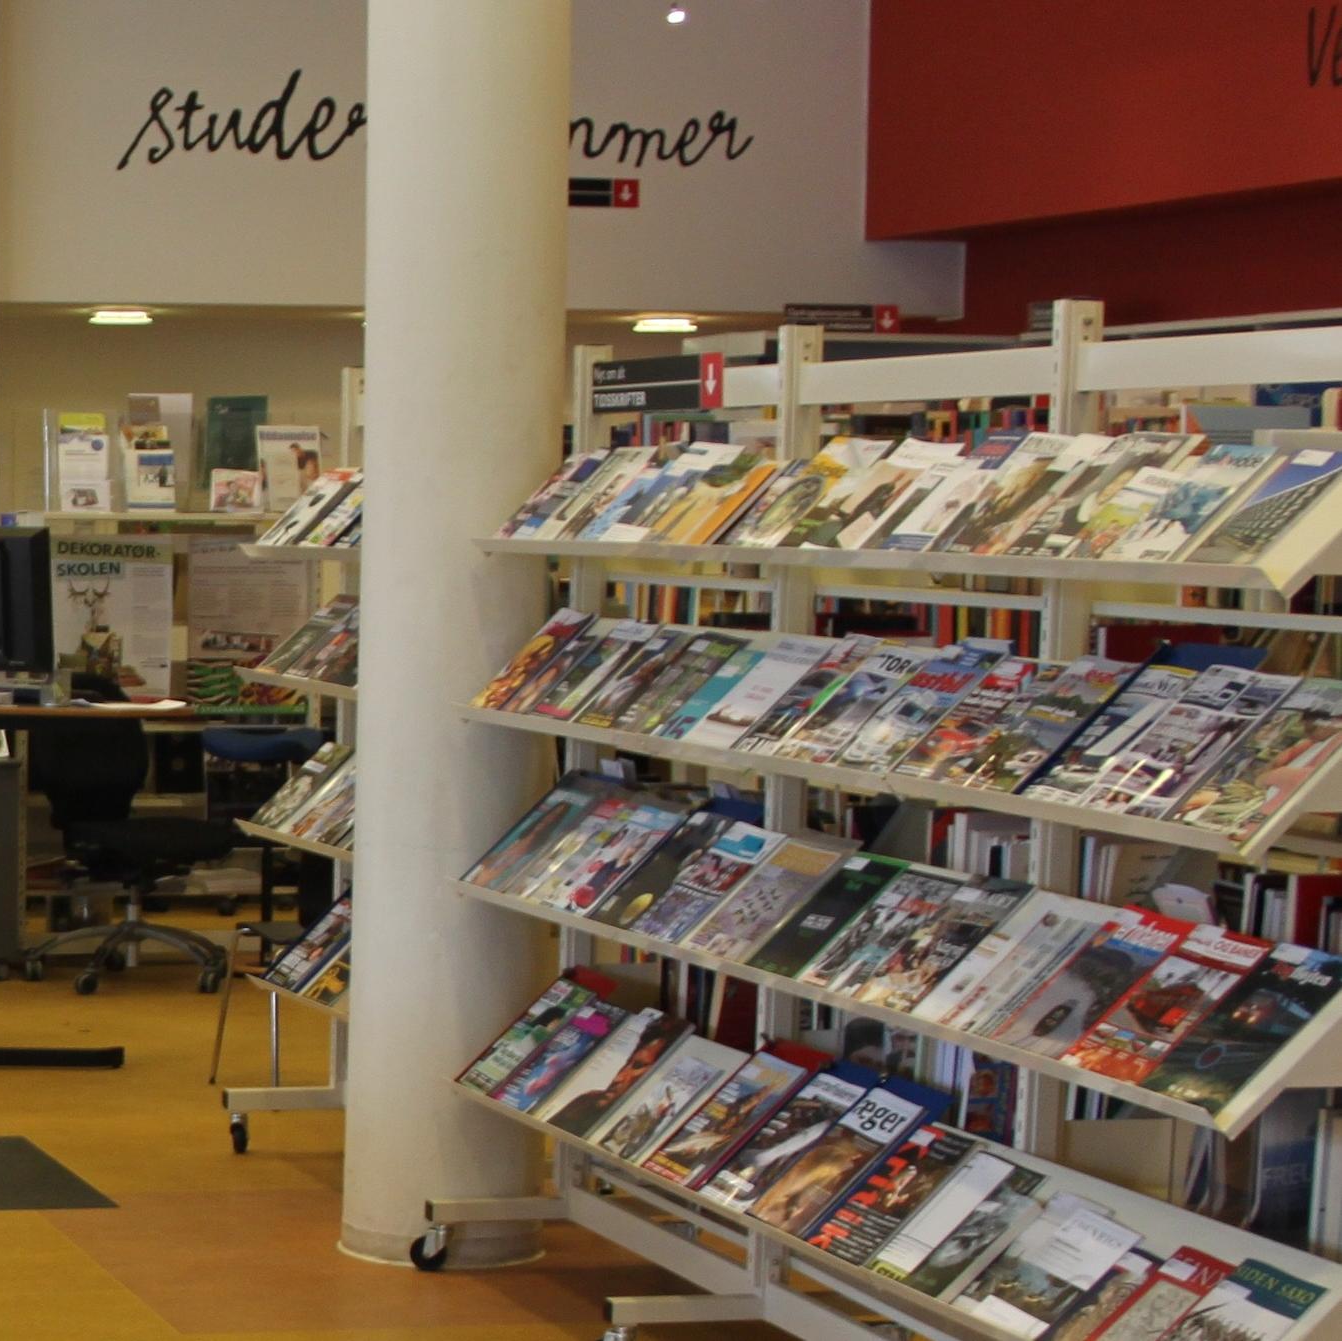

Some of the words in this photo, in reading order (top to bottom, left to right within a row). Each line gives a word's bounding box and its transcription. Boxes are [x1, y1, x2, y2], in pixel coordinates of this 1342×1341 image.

[56, 561, 121, 577] SKOLEN
[878, 653, 912, 674] TOR
[855, 1100, 907, 1133] æger
